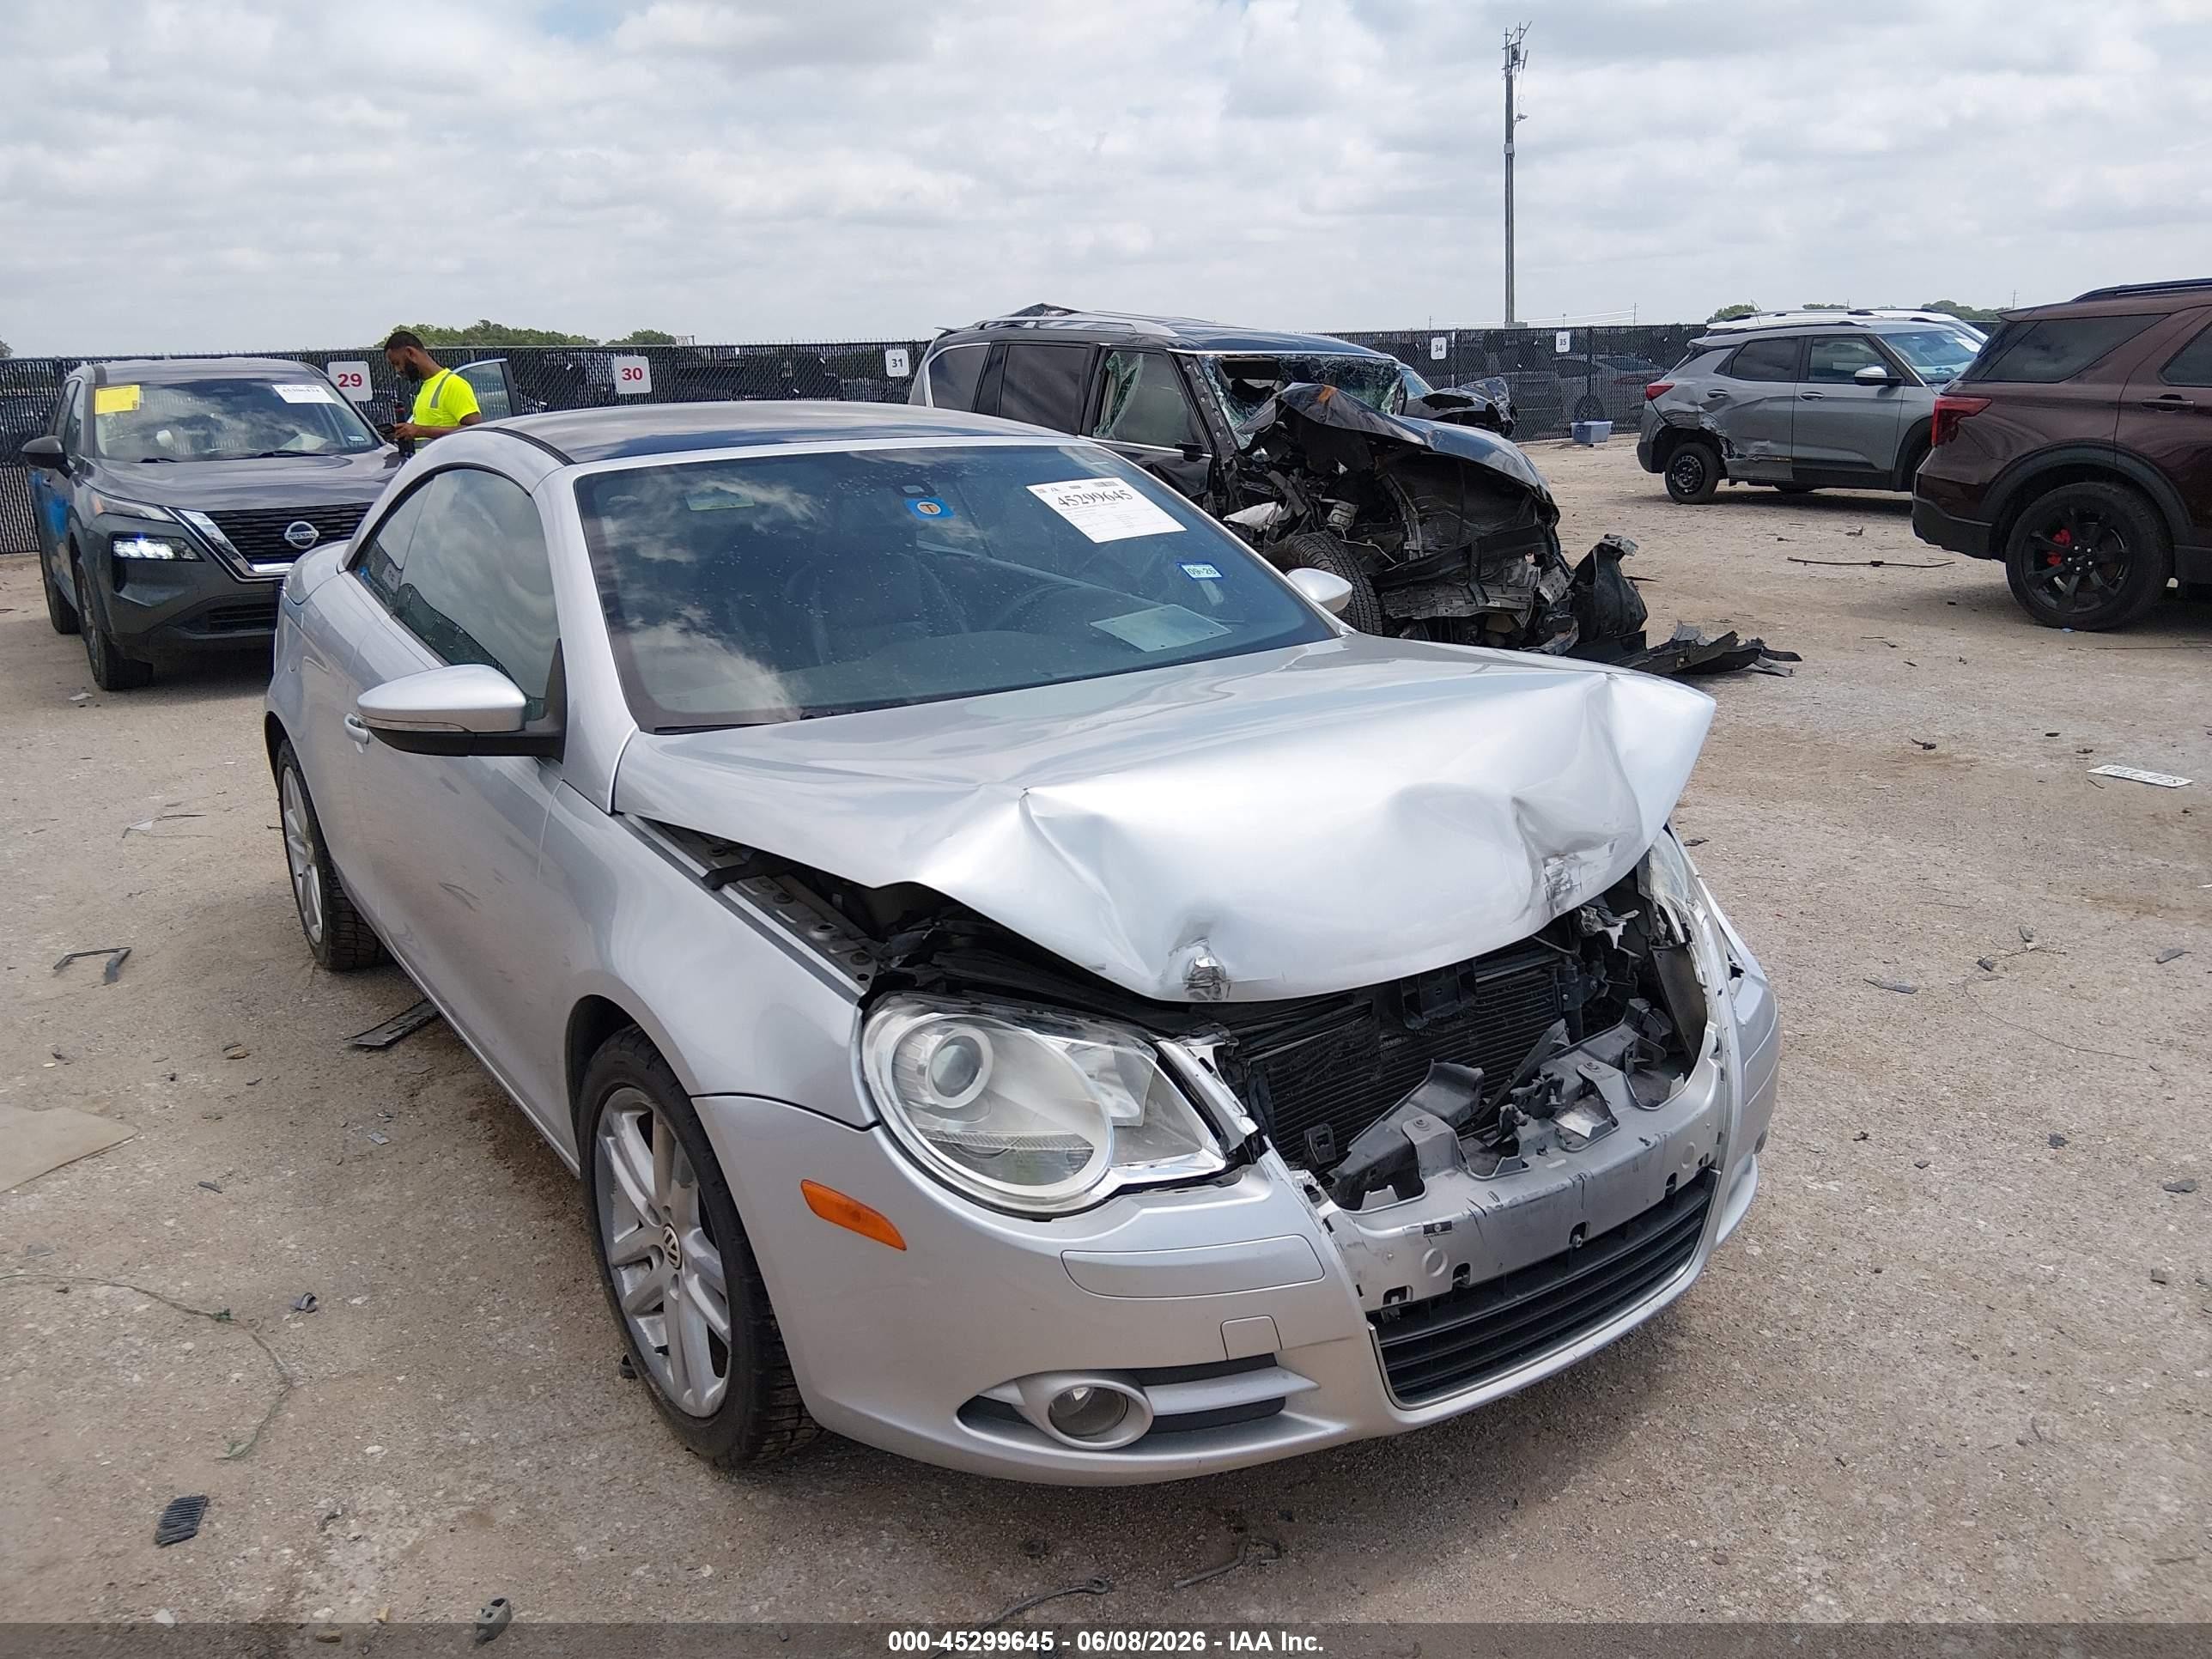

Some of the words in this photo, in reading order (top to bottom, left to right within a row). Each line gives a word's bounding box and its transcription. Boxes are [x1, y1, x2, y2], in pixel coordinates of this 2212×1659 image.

[891, 357, 903, 368] 31
[337, 373, 362, 388] 29
[621, 367, 643, 381] 30
[1057, 489, 1133, 507] 45299645
